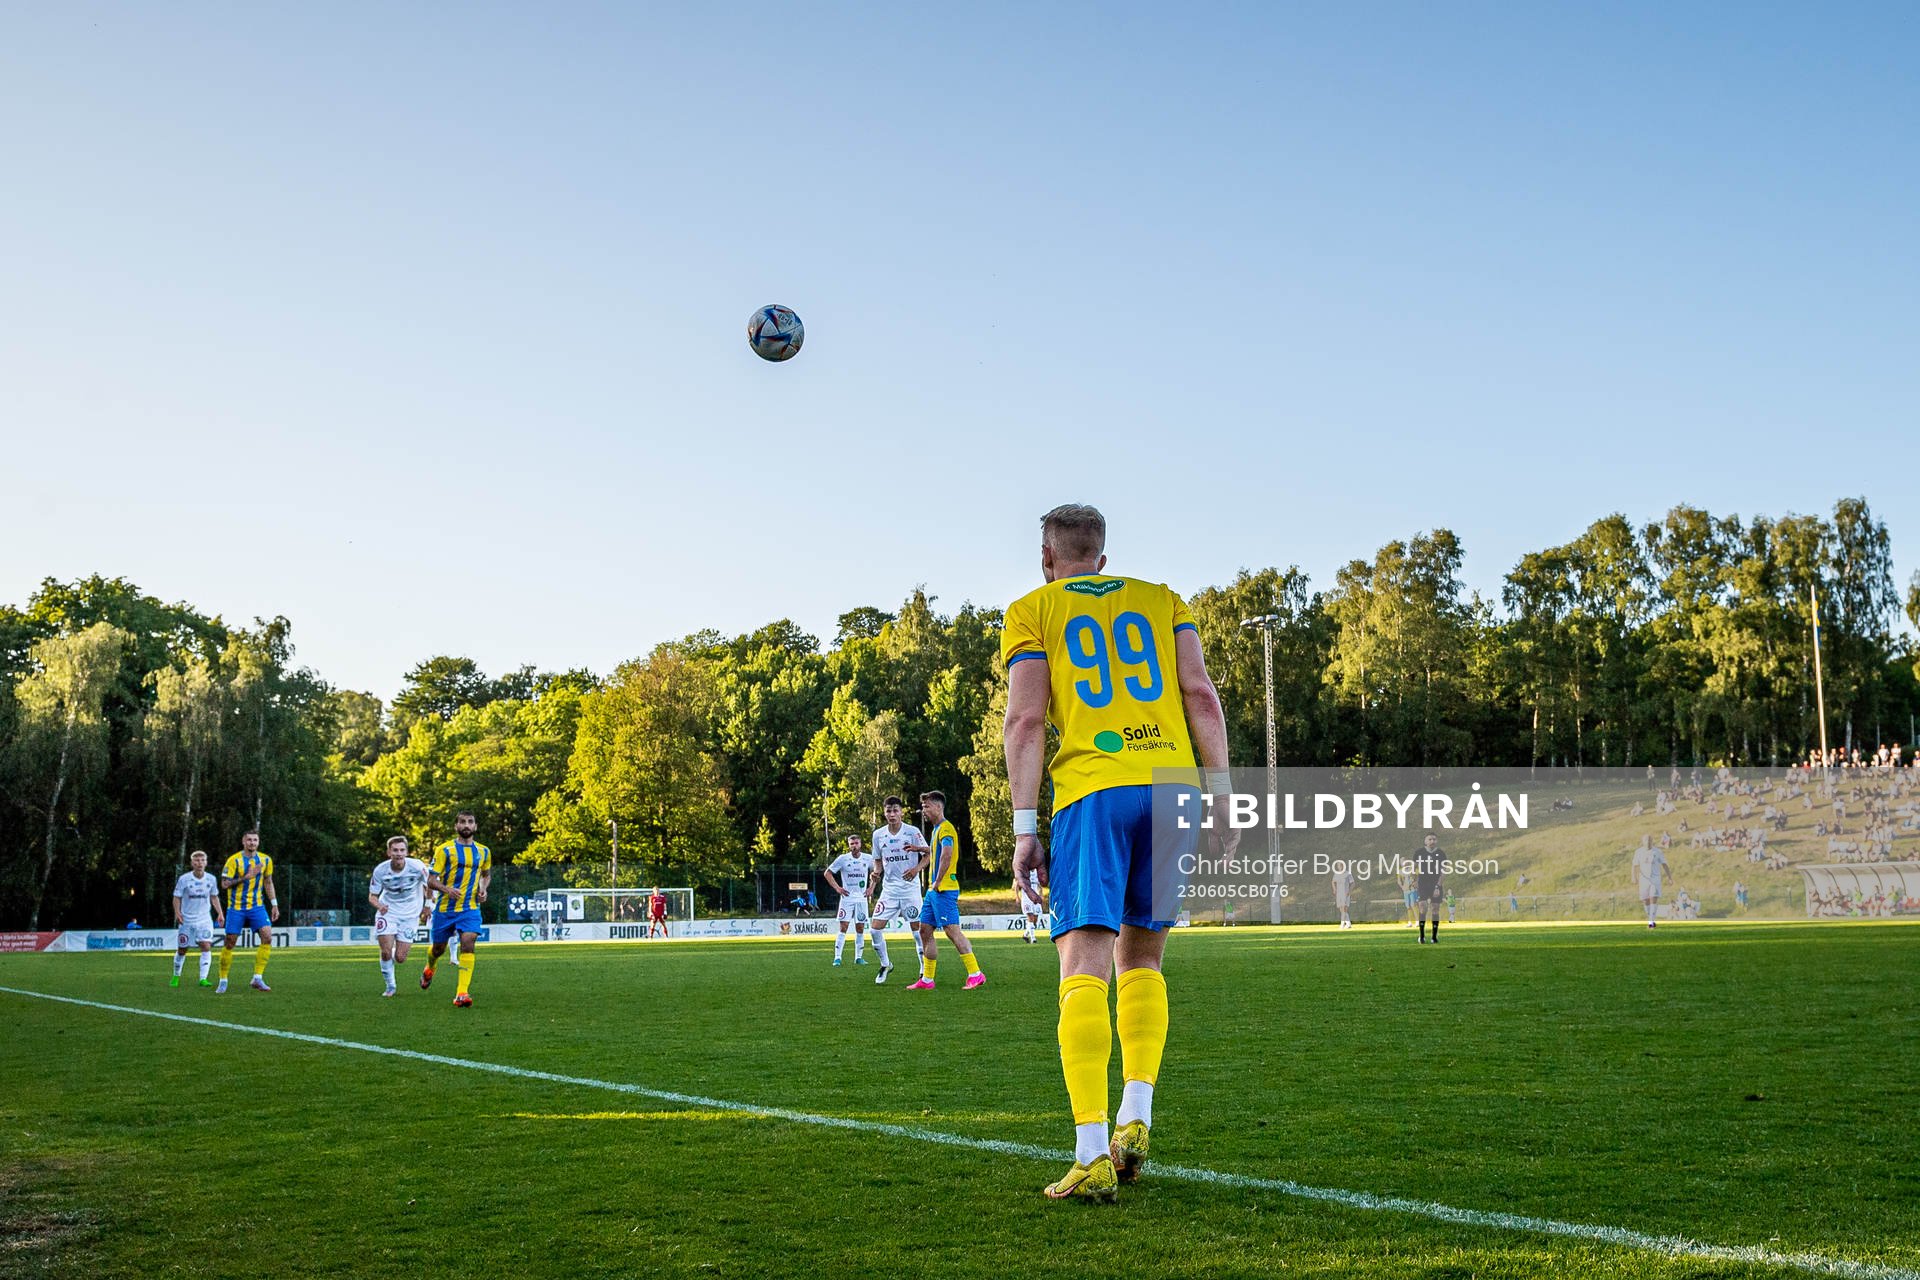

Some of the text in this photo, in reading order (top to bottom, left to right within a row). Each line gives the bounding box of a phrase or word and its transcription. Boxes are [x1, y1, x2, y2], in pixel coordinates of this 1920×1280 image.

[1065, 611, 1164, 709] 99
[1123, 724, 1161, 741] Solid
[1127, 740, 1177, 752] Försäkring
